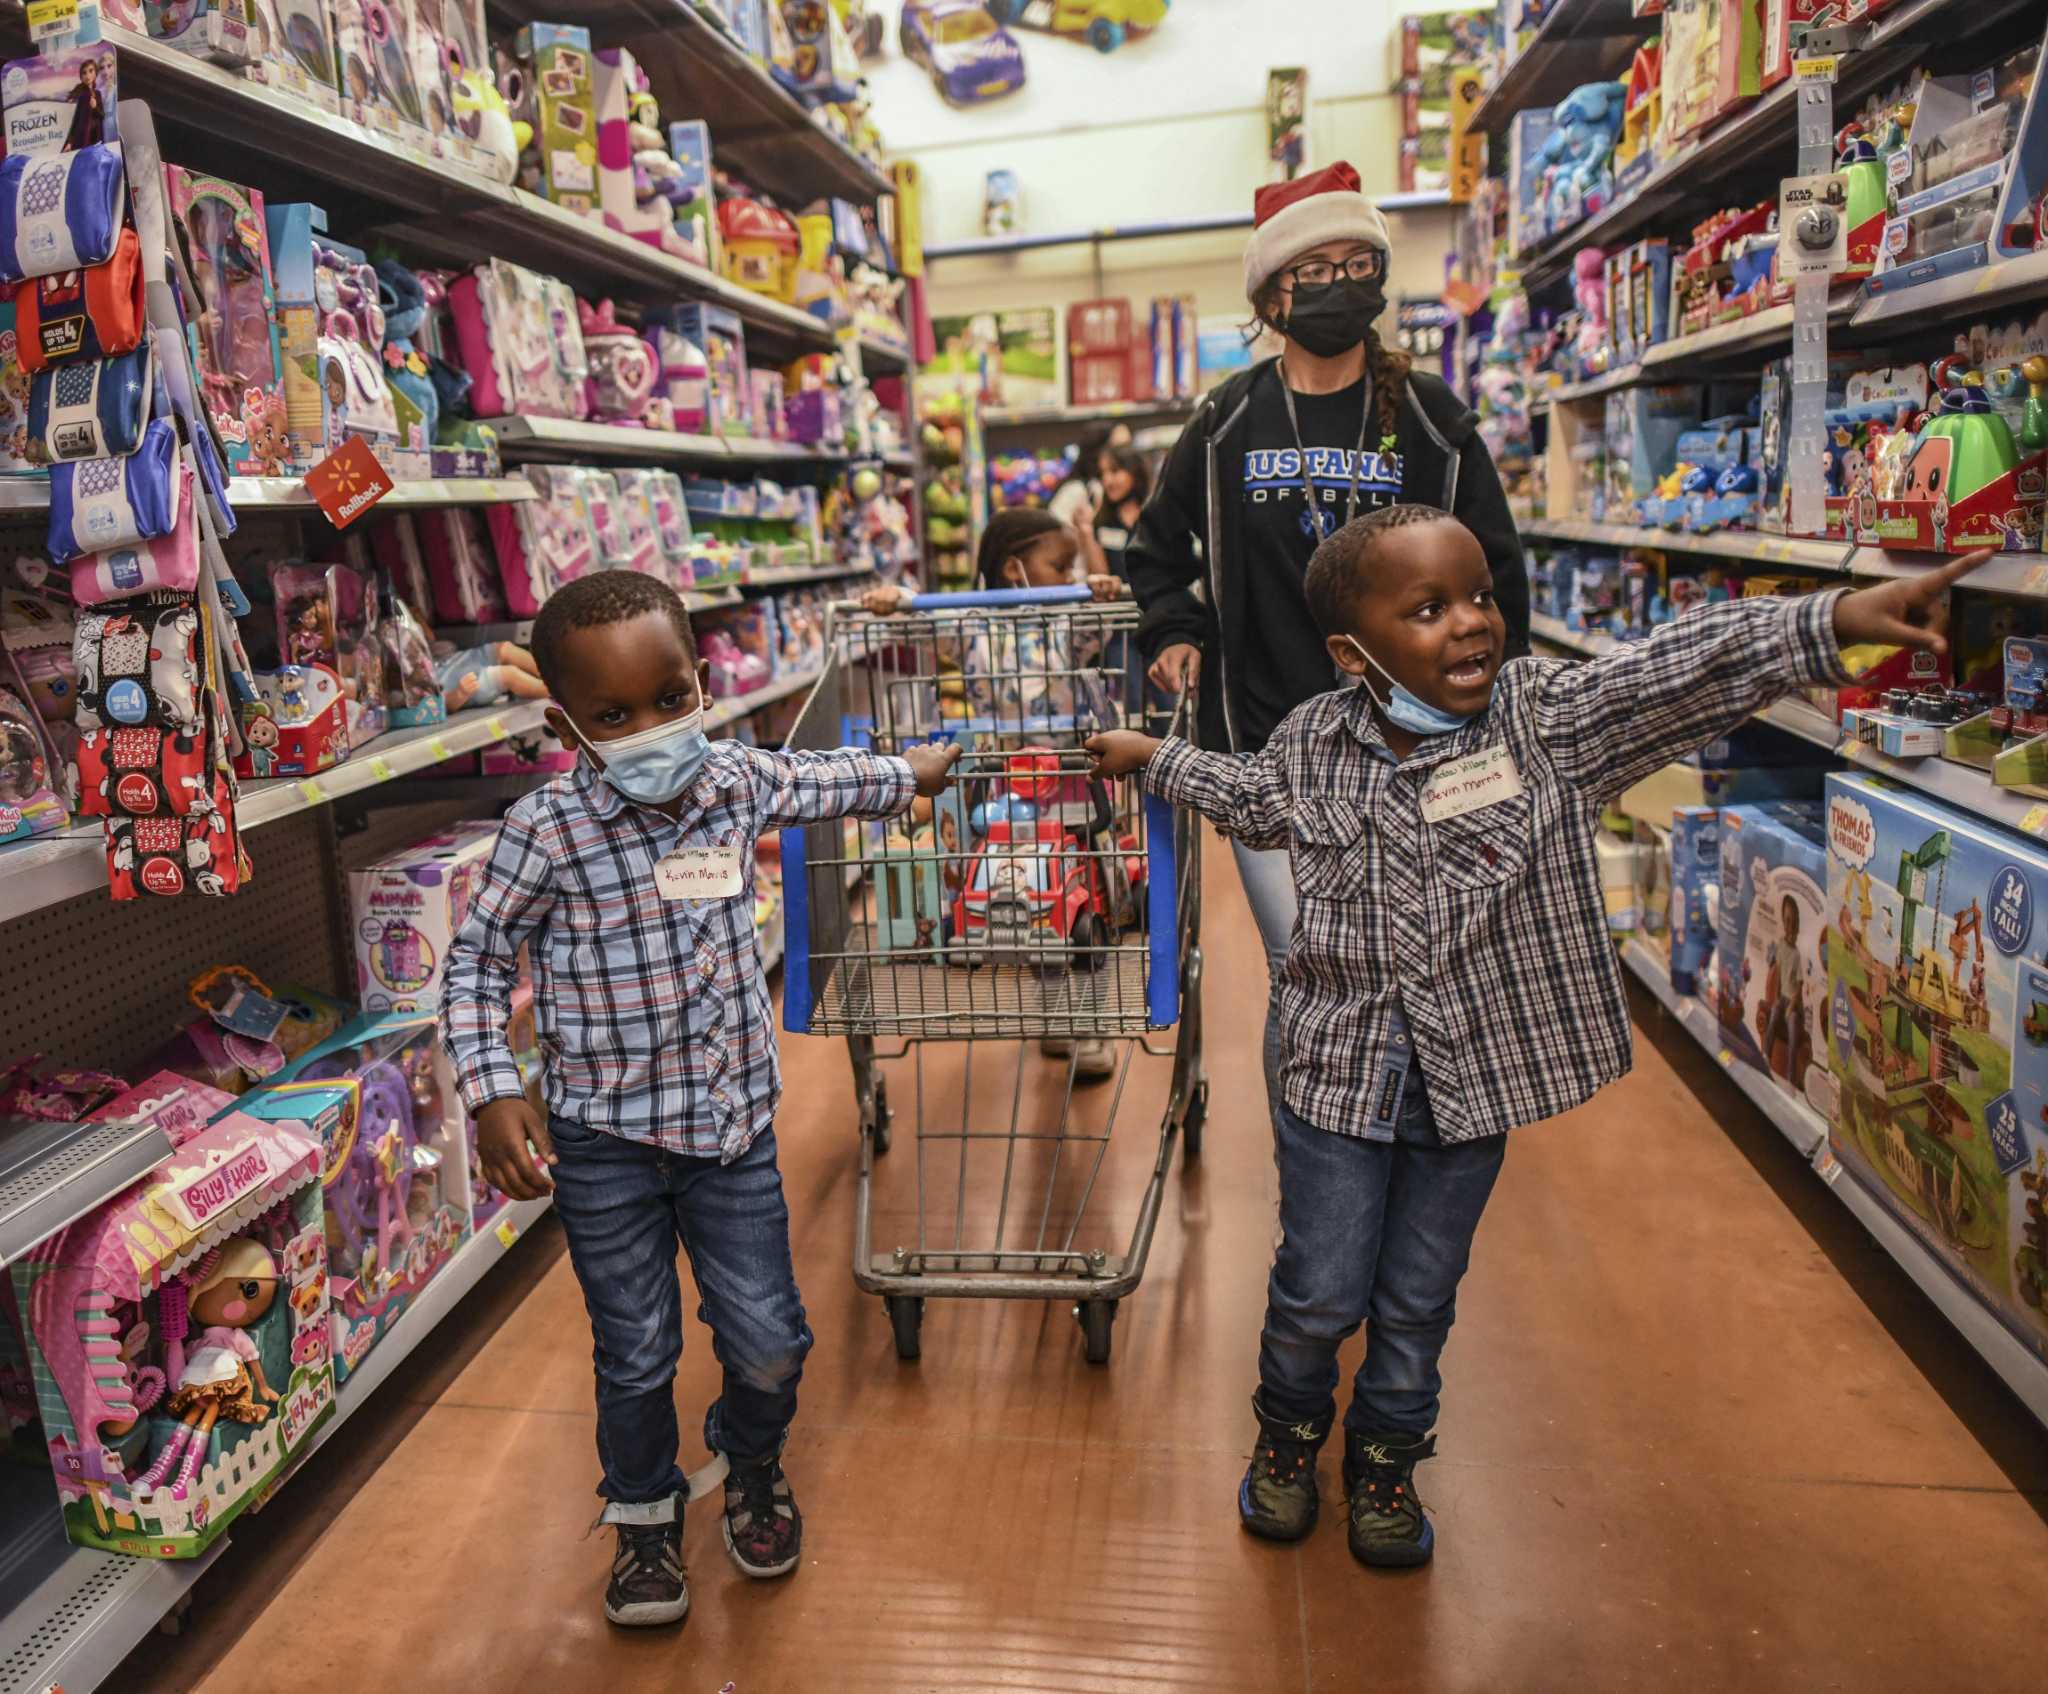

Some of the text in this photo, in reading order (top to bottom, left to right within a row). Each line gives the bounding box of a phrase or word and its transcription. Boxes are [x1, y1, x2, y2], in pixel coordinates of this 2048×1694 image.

[11, 113, 58, 136] FROZEN
[1785, 194, 1812, 203] WARS
[1788, 188, 1813, 197] STAR
[43, 327, 64, 338] HOLDS
[64, 320, 77, 341] 4
[46, 335, 66, 347] UP TO
[58, 432, 77, 441] HOLDS
[79, 426, 89, 445] 4
[337, 481, 383, 519] Rollback
[127, 557, 138, 572] 4
[131, 688, 141, 709] 4
[141, 783, 152, 801] 4
[1425, 771, 1503, 805] Devin Morris
[1831, 806, 1870, 843] THOMAS
[1839, 829, 1866, 858] FRIENDS
[166, 866, 177, 884] 4
[665, 866, 728, 882] Kevin Morris
[2003, 873, 2025, 908] 34
[1994, 905, 2022, 941] TALL!
[1999, 1101, 2017, 1133] 25
[1992, 1127, 2019, 1161] TRACK!
[67, 1458, 80, 1470] 10
